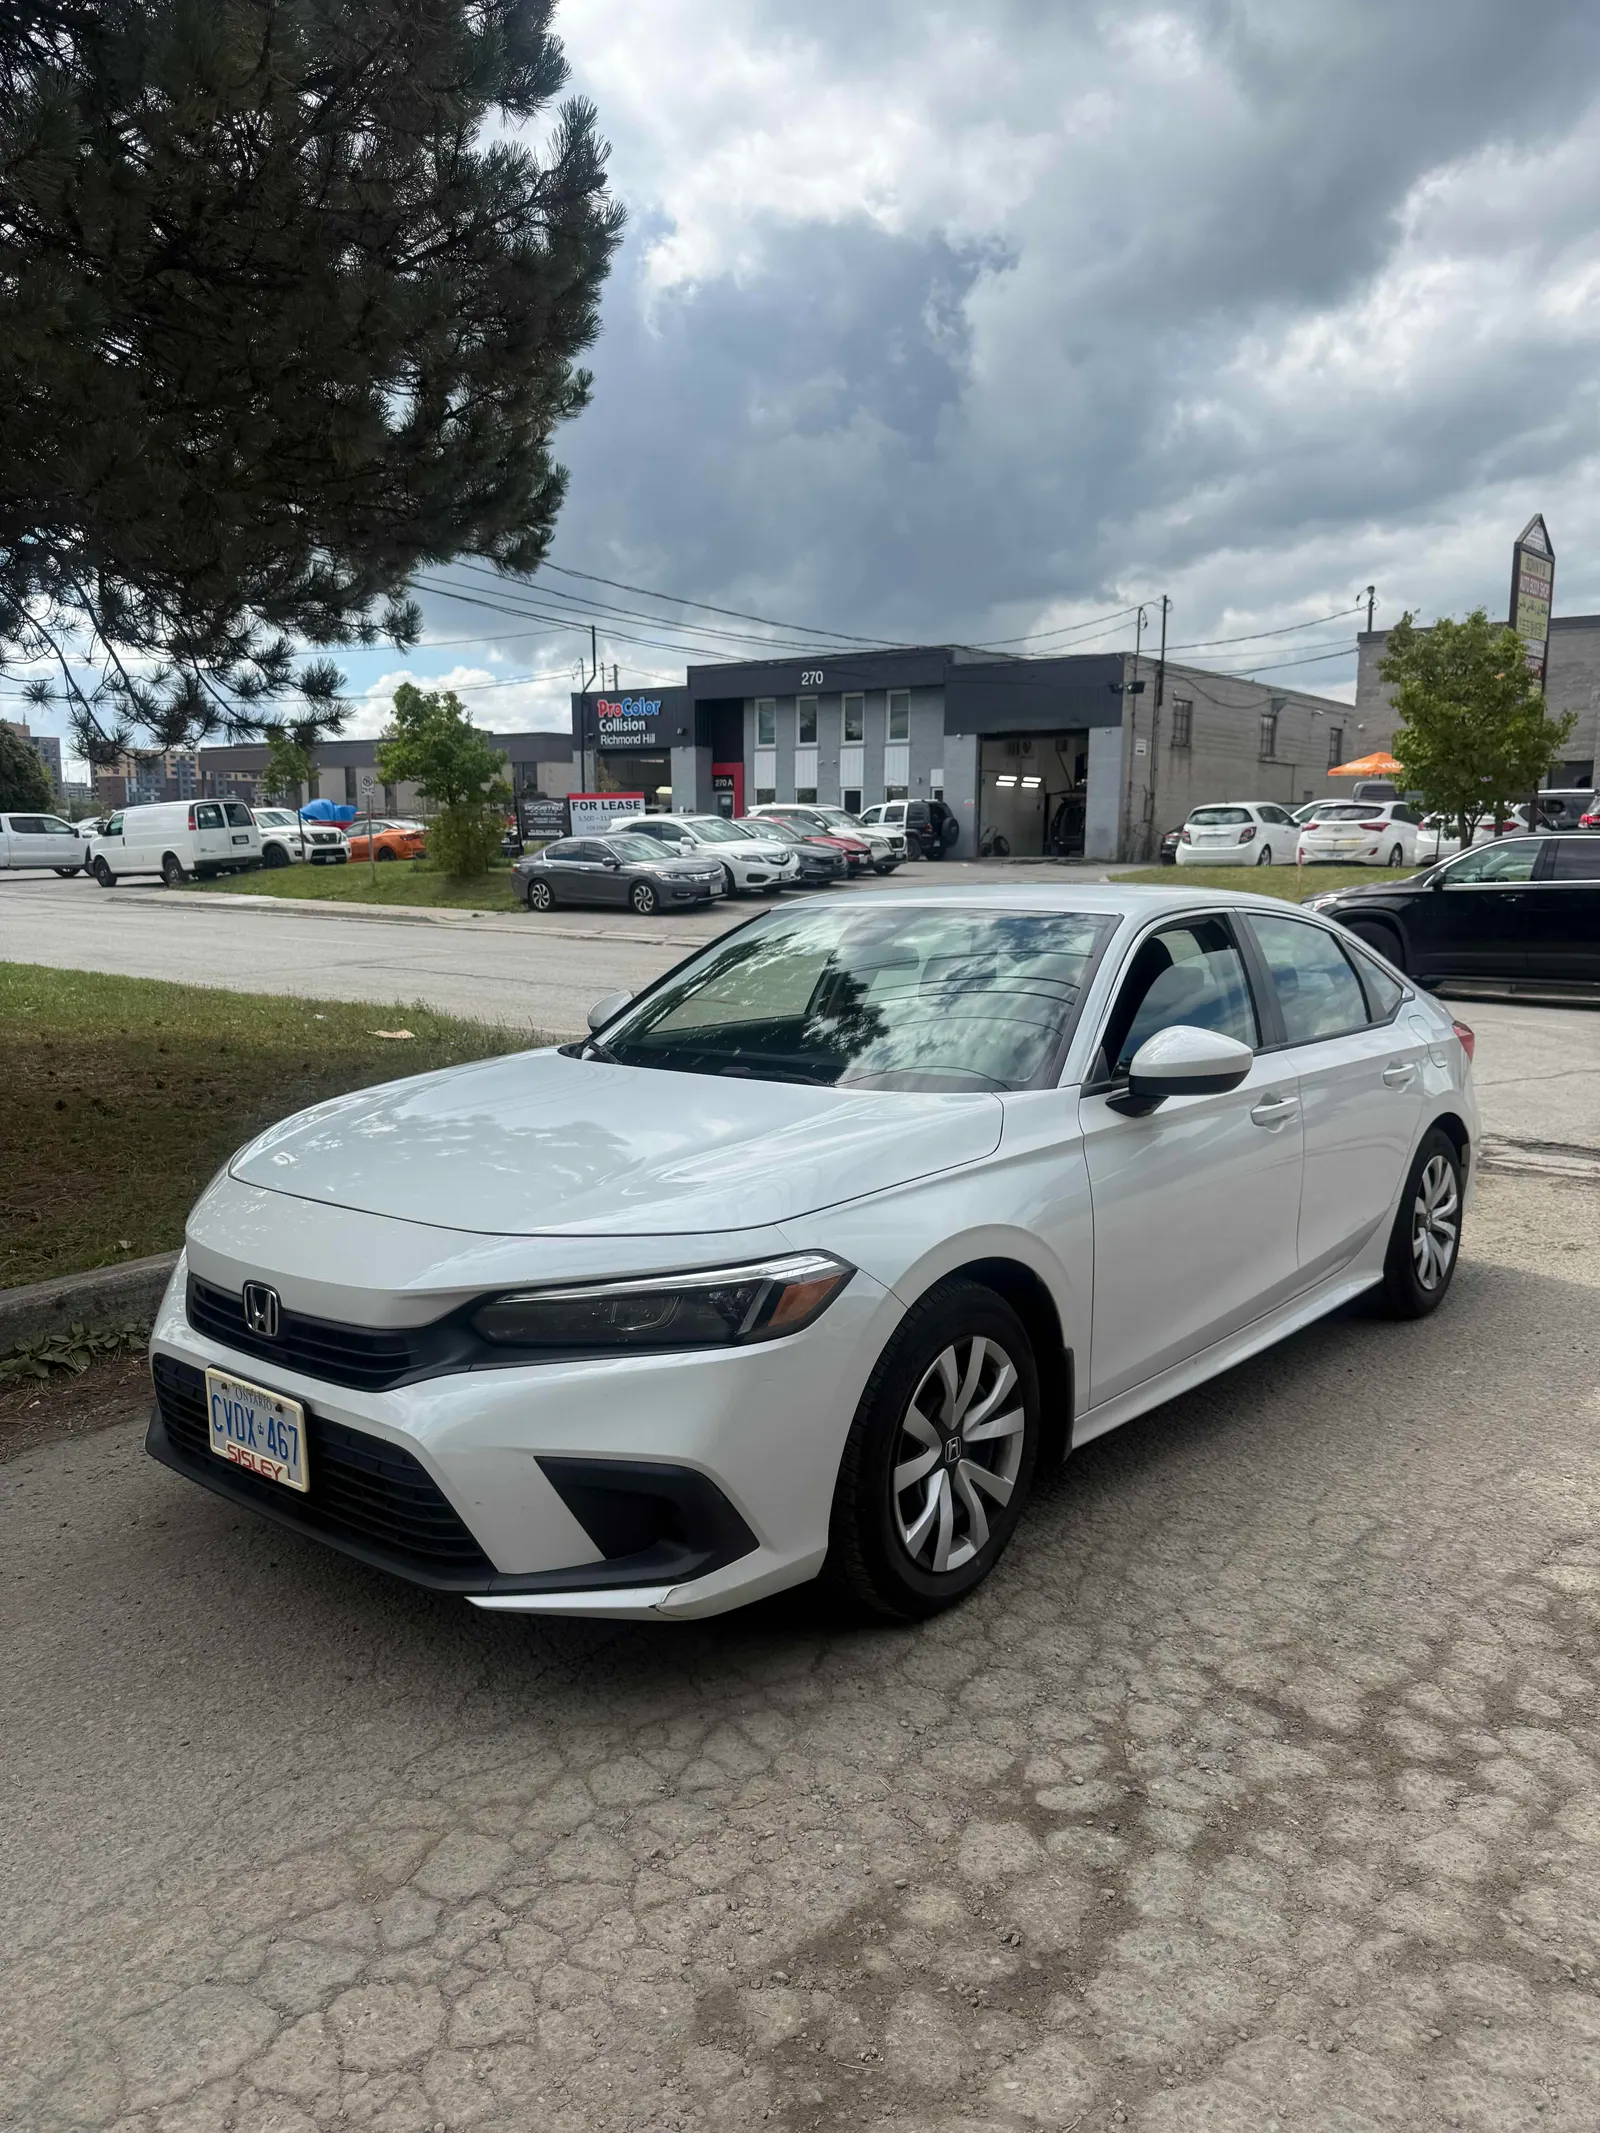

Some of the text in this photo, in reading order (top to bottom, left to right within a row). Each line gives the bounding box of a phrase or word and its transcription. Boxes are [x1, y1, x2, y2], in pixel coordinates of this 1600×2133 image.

[801, 670, 824, 685] 270
[597, 696, 661, 718] ProColor
[599, 718, 646, 732] Collision
[600, 733, 656, 745] Richmond Hill
[715, 779, 733, 787] 270 A
[572, 800, 641, 811] FOR LEASE
[235, 1386, 273, 1411] ONTARIO
[212, 1393, 297, 1466] CVDX 467
[227, 1444, 283, 1480] SISLEY
